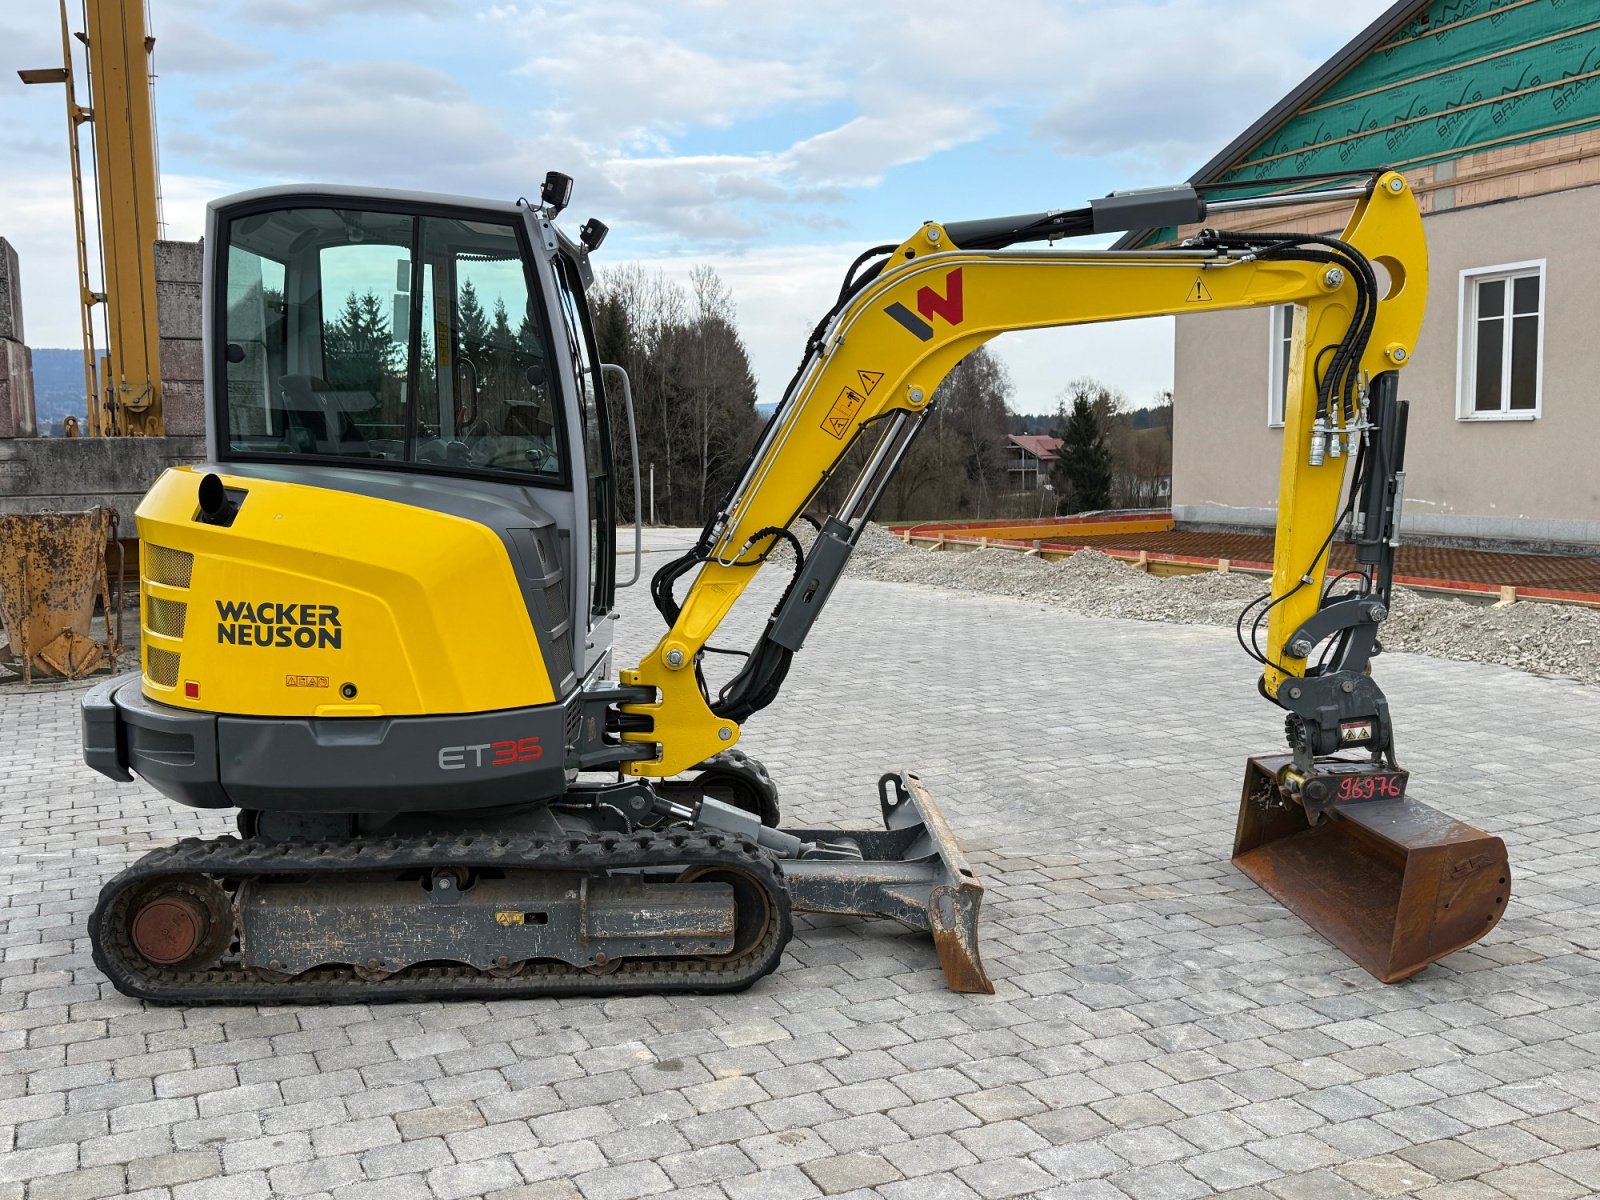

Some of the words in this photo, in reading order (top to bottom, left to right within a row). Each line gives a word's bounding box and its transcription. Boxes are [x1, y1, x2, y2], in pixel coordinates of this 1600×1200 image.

[215, 600, 342, 626] WACKER
[217, 623, 342, 650] NEUSON
[438, 736, 543, 770] ET35
[1337, 775, 1401, 799] 96976
